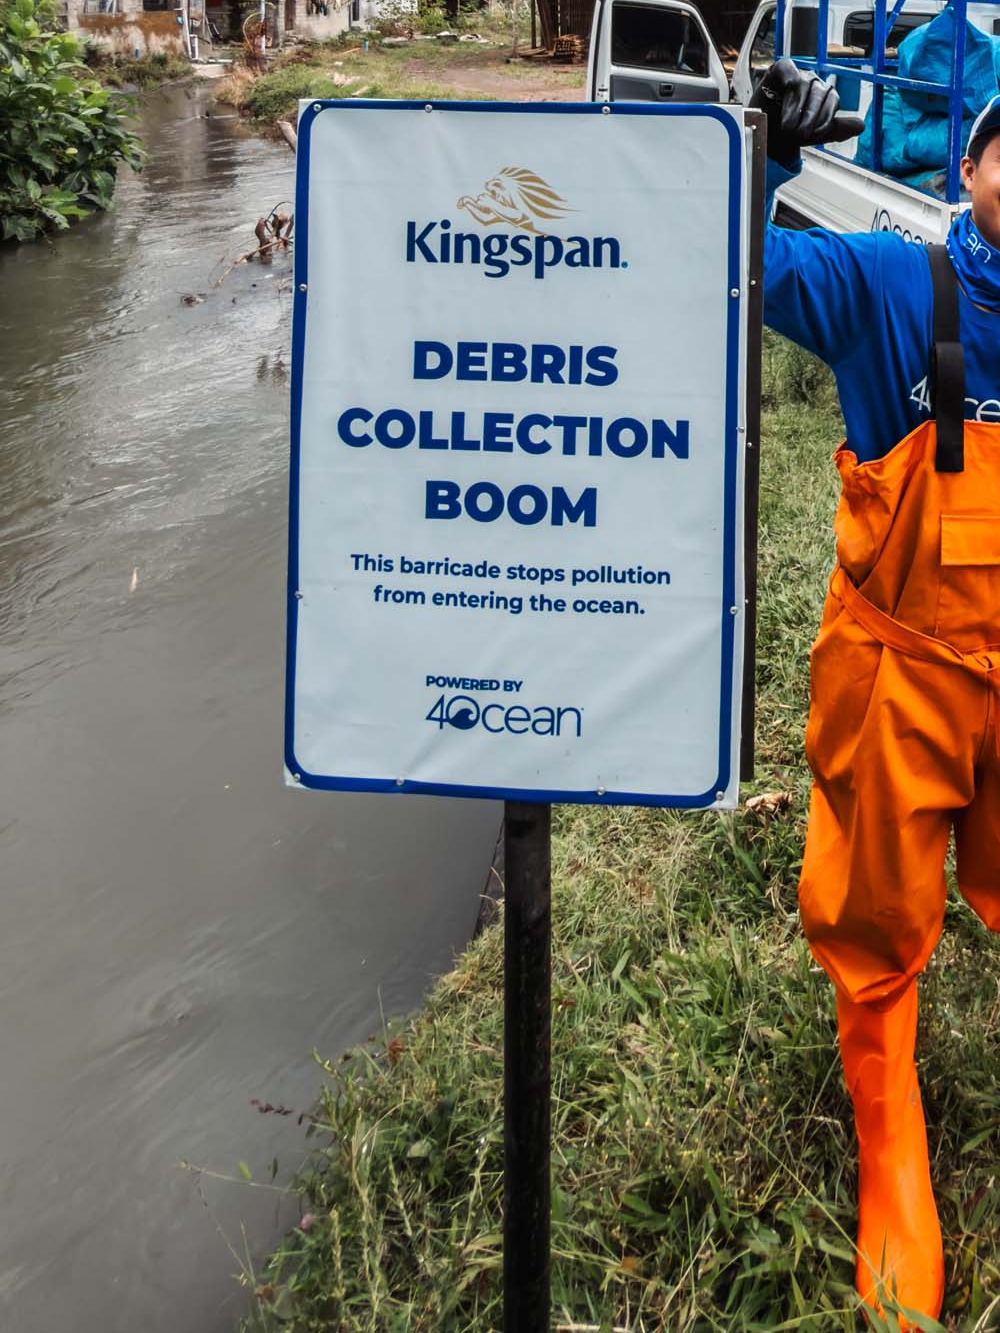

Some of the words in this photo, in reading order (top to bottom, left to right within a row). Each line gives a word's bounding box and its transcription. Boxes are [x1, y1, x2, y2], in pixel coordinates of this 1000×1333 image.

[412, 340, 619, 387] DEBRIS
[336, 407, 690, 460] COLLECTION
[424, 479, 598, 528] BOOM
[350, 553, 395, 573] This
[399, 556, 502, 580] barricade
[506, 563, 566, 585] stops
[571, 565, 672, 587] pollution
[373, 584, 426, 605] from
[431, 590, 523, 615] entering
[528, 593, 567, 613] the
[572, 599, 646, 615] ocean.
[425, 675, 501, 691] POWERED
[502, 679, 524, 693] BY
